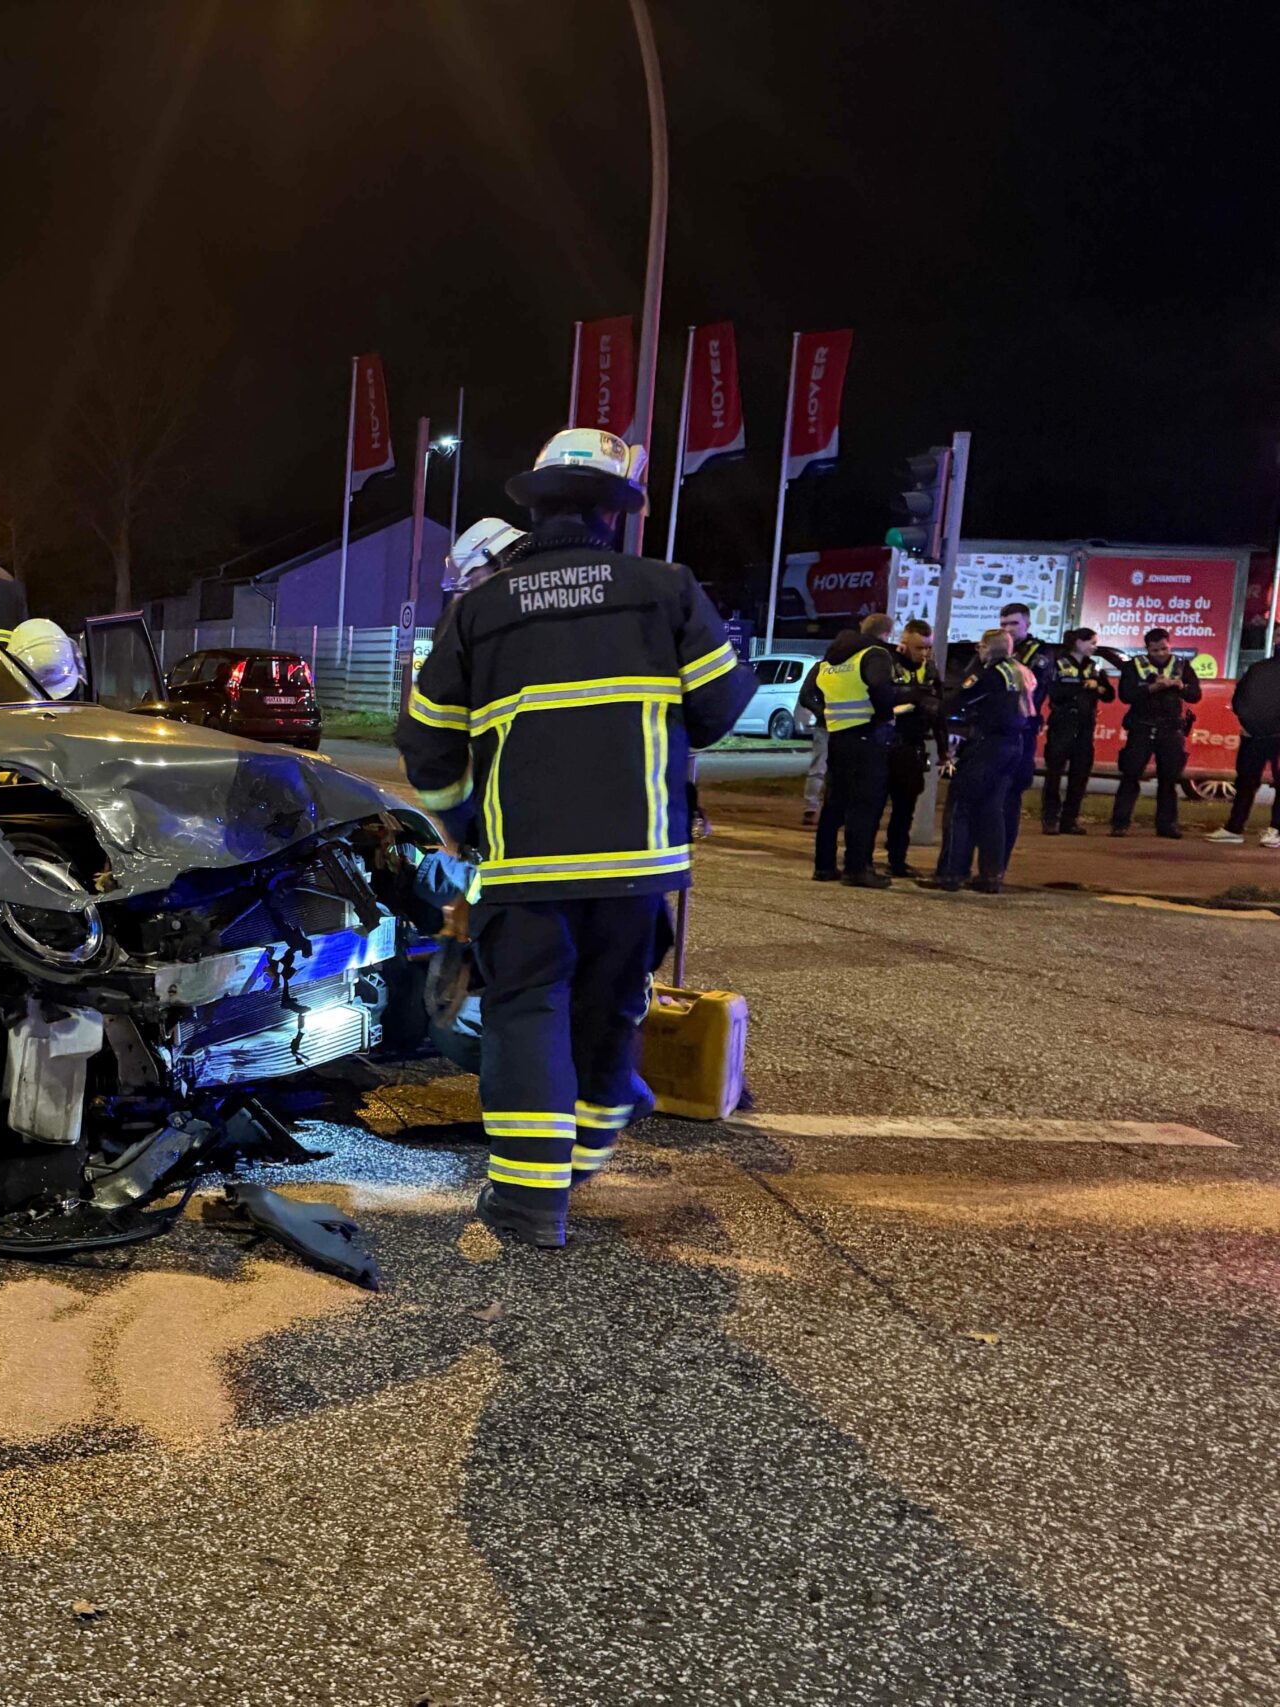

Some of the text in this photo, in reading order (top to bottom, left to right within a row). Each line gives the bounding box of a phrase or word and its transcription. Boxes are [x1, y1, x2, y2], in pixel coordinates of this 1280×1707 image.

[596, 335, 612, 425] HOYER
[708, 339, 725, 429] HOYER
[807, 346, 829, 434] HOYER
[365, 367, 381, 449] HOYER
[508, 564, 614, 596] FEUERWEHR
[813, 571, 874, 590] HOYER
[1145, 574, 1192, 584] JOHANNITER
[520, 583, 606, 614] HAMBURG
[1107, 594, 1211, 611] Das Abo, das du
[1093, 623, 1140, 637] Andere
[1174, 625, 1216, 638] schon.
[1107, 610, 1204, 625] nicht brauchst.
